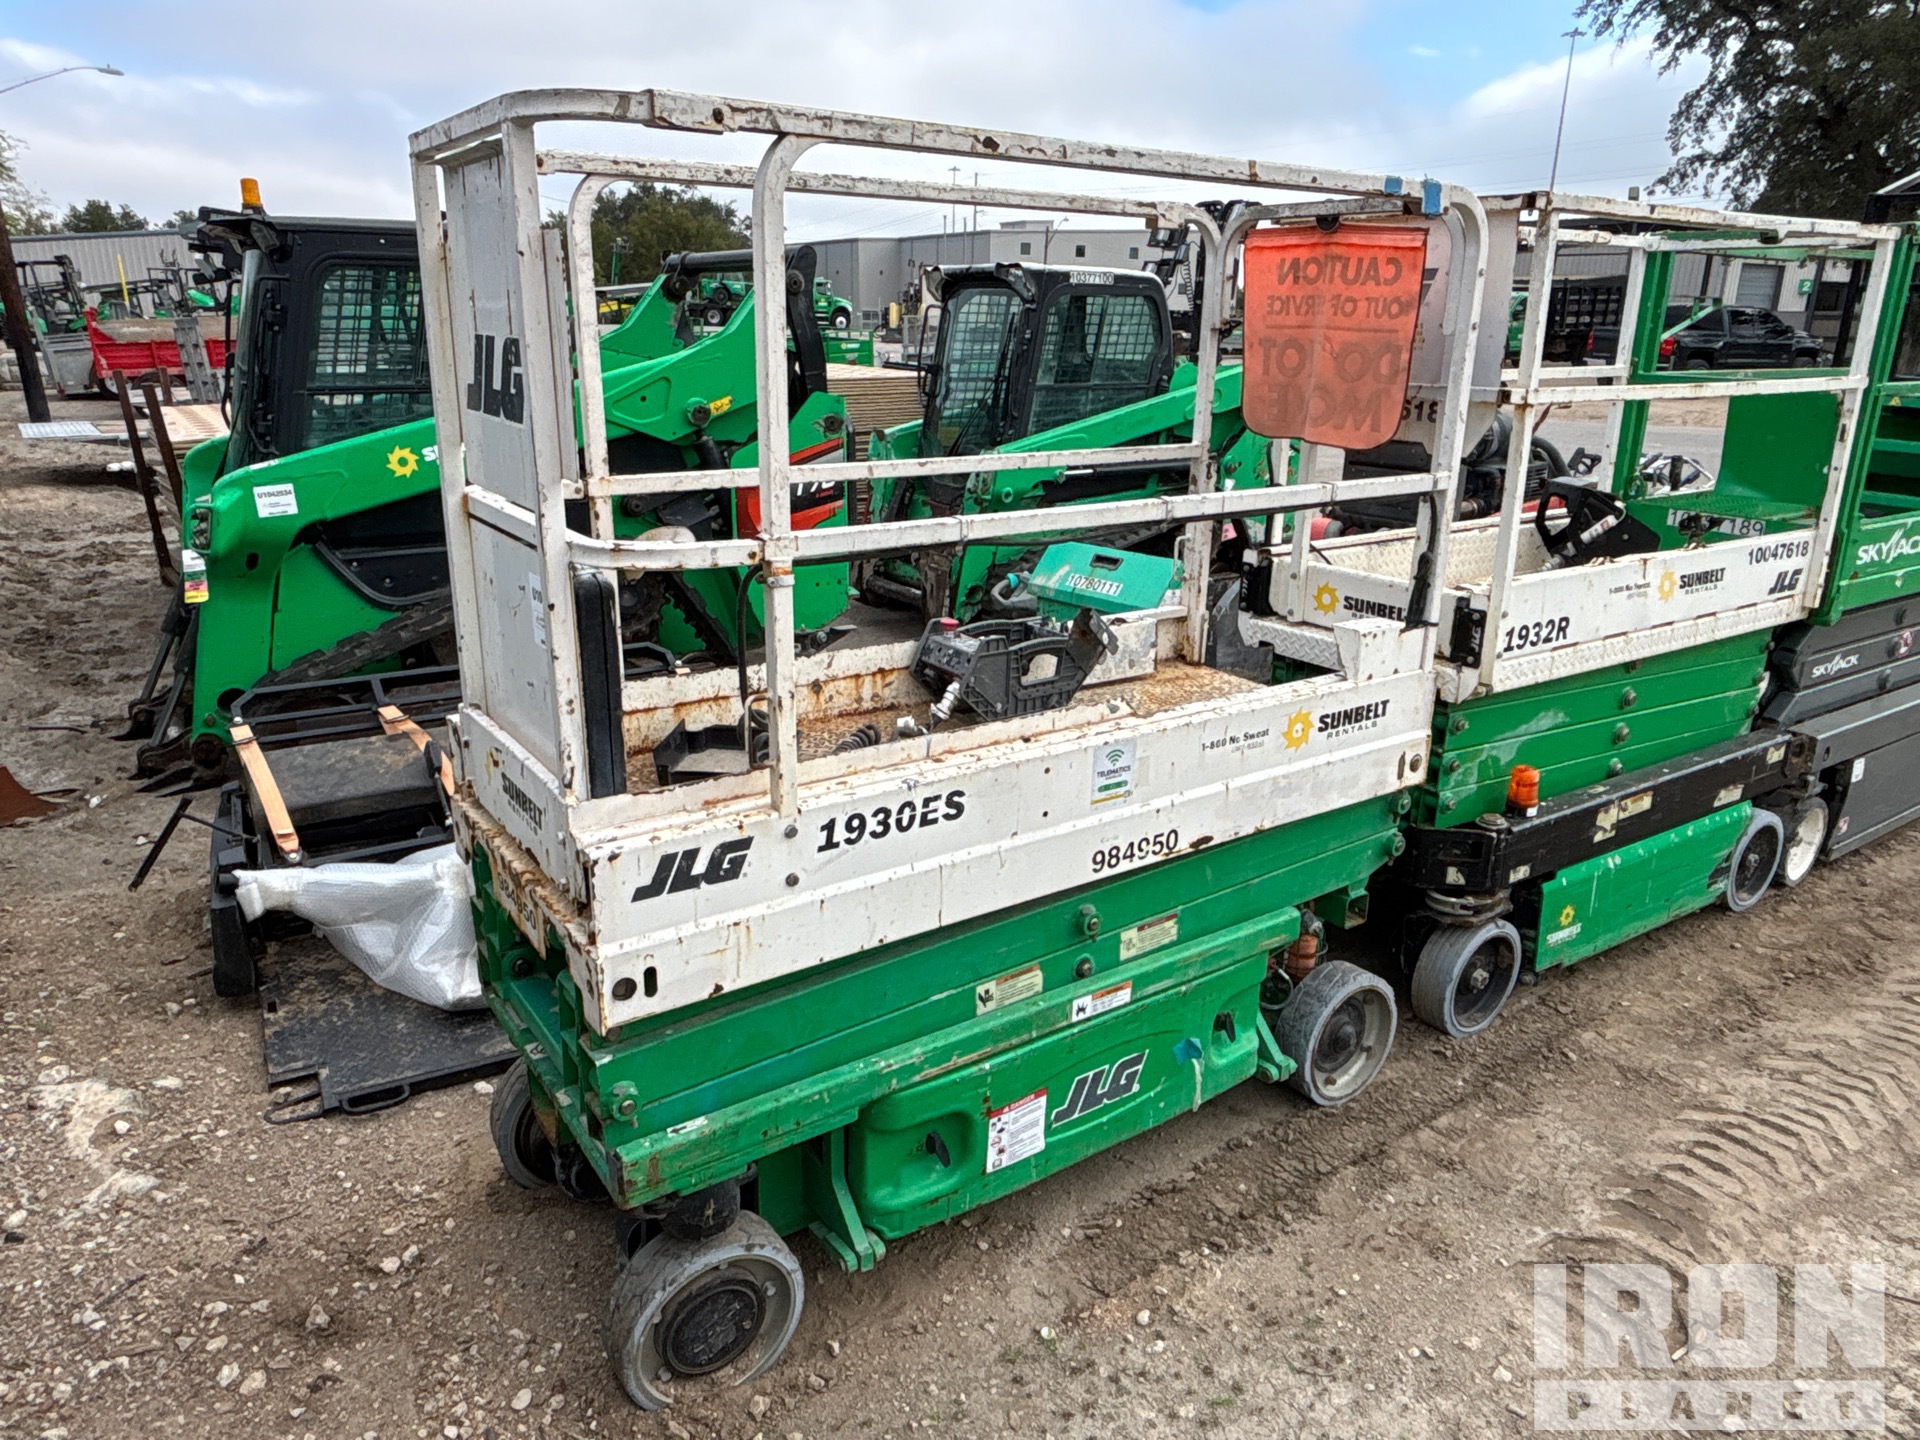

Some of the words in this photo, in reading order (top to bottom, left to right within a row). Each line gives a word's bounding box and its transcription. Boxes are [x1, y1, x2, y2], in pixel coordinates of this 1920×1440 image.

[1802, 281, 1811, 292] 2
[467, 334, 524, 425] JLG
[1749, 541, 1810, 566] 10047618
[1068, 575, 1121, 595] 10780111
[1679, 568, 1726, 589] SUNBELT
[1768, 568, 1803, 596] JLG
[1343, 596, 1407, 620] SUNBEL
[1471, 625, 1482, 653] JLG
[1503, 616, 1571, 653] 1932R
[1811, 653, 1860, 678] SKYJACK
[1318, 699, 1390, 733] SUNBELT
[1243, 728, 1269, 742] Sweat
[1327, 721, 1378, 740] RENTALS
[1096, 765, 1131, 778] TELEMATICS
[501, 772, 543, 831] SUNBELT
[817, 790, 966, 853] 1930ES
[1092, 829, 1178, 873] 984950
[631, 836, 755, 903] JLG
[1050, 1049, 1149, 1129] JLG
